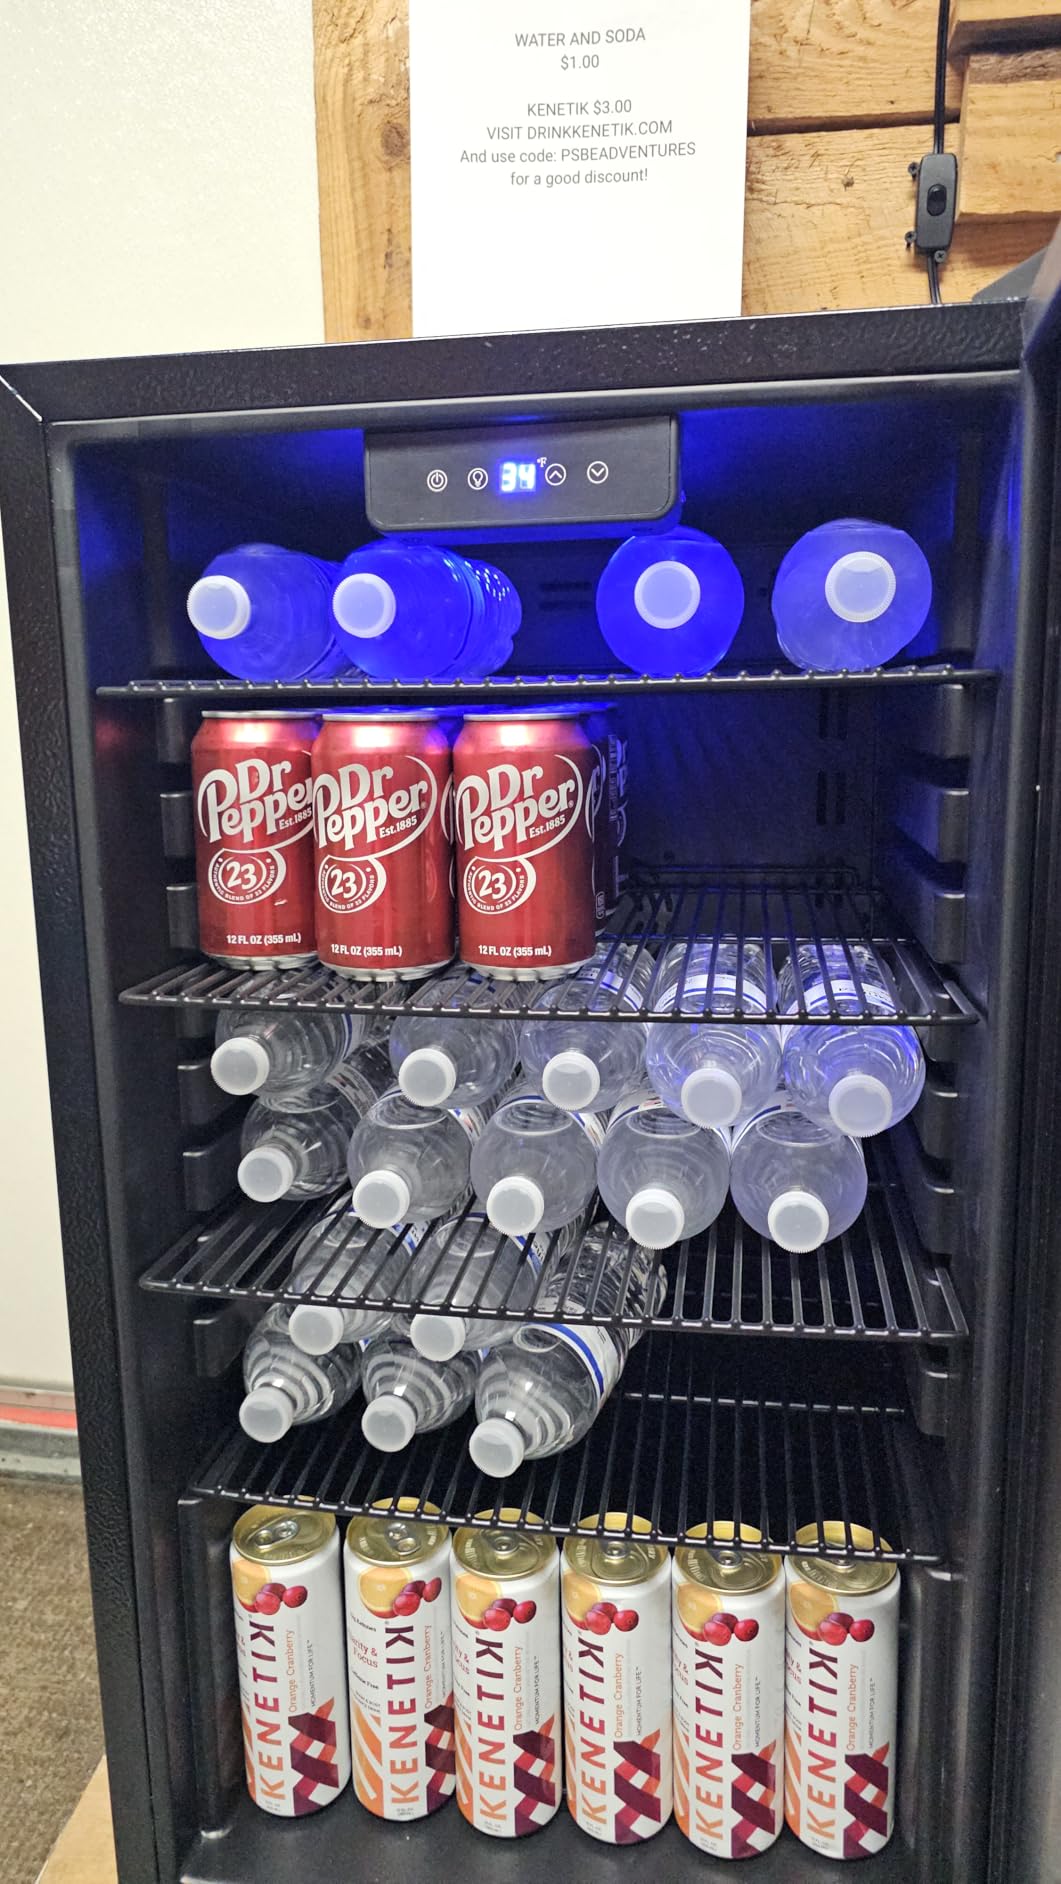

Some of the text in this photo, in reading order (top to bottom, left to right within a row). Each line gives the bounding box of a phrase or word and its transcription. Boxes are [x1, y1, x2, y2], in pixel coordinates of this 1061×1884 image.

[515, 27, 646, 47] WATER AND SODA
[560, 53, 600, 71] $1.00
[486, 120, 673, 140] VISIT DRINKKENETIK.COM
[527, 99, 632, 117] KENETIK $3.00
[460, 141, 696, 163] And use code: PSBEADVENTURES
[510, 168, 648, 188] for a good discount!
[501, 461, 536, 491] 34
[235, 759, 292, 804] Dr
[338, 763, 394, 811] Dr
[486, 763, 544, 811] Dr
[313, 773, 428, 851] Pepper
[456, 775, 576, 852] Pepper
[226, 861, 257, 890] 23
[330, 869, 357, 899] 23
[478, 869, 507, 899] 23
[226, 932, 302, 947] 12 FL OZ (355 mL)
[331, 944, 403, 958] 12 FL OZ (355 mL)
[478, 944, 552, 958] 12 FL OZ (355 mL)
[286, 1630, 298, 1712] Orange Cranberry
[424, 1625, 433, 1709] Orange Cranberry
[513, 1646, 524, 1731] Orange Cranberry
[249, 1619, 286, 1801] KENETIK
[384, 1626, 420, 1804] KENETIK
[613, 1653, 624, 1738] Orange Cranberry
[733, 1664, 744, 1751] Orange Cranberry
[846, 1664, 859, 1751] Orange Cranberry
[475, 1637, 508, 1820] KENETIK
[578, 1636, 607, 1825] KENETIK
[694, 1648, 724, 1840] KENETIK
[806, 1647, 839, 1840] KENETIK
